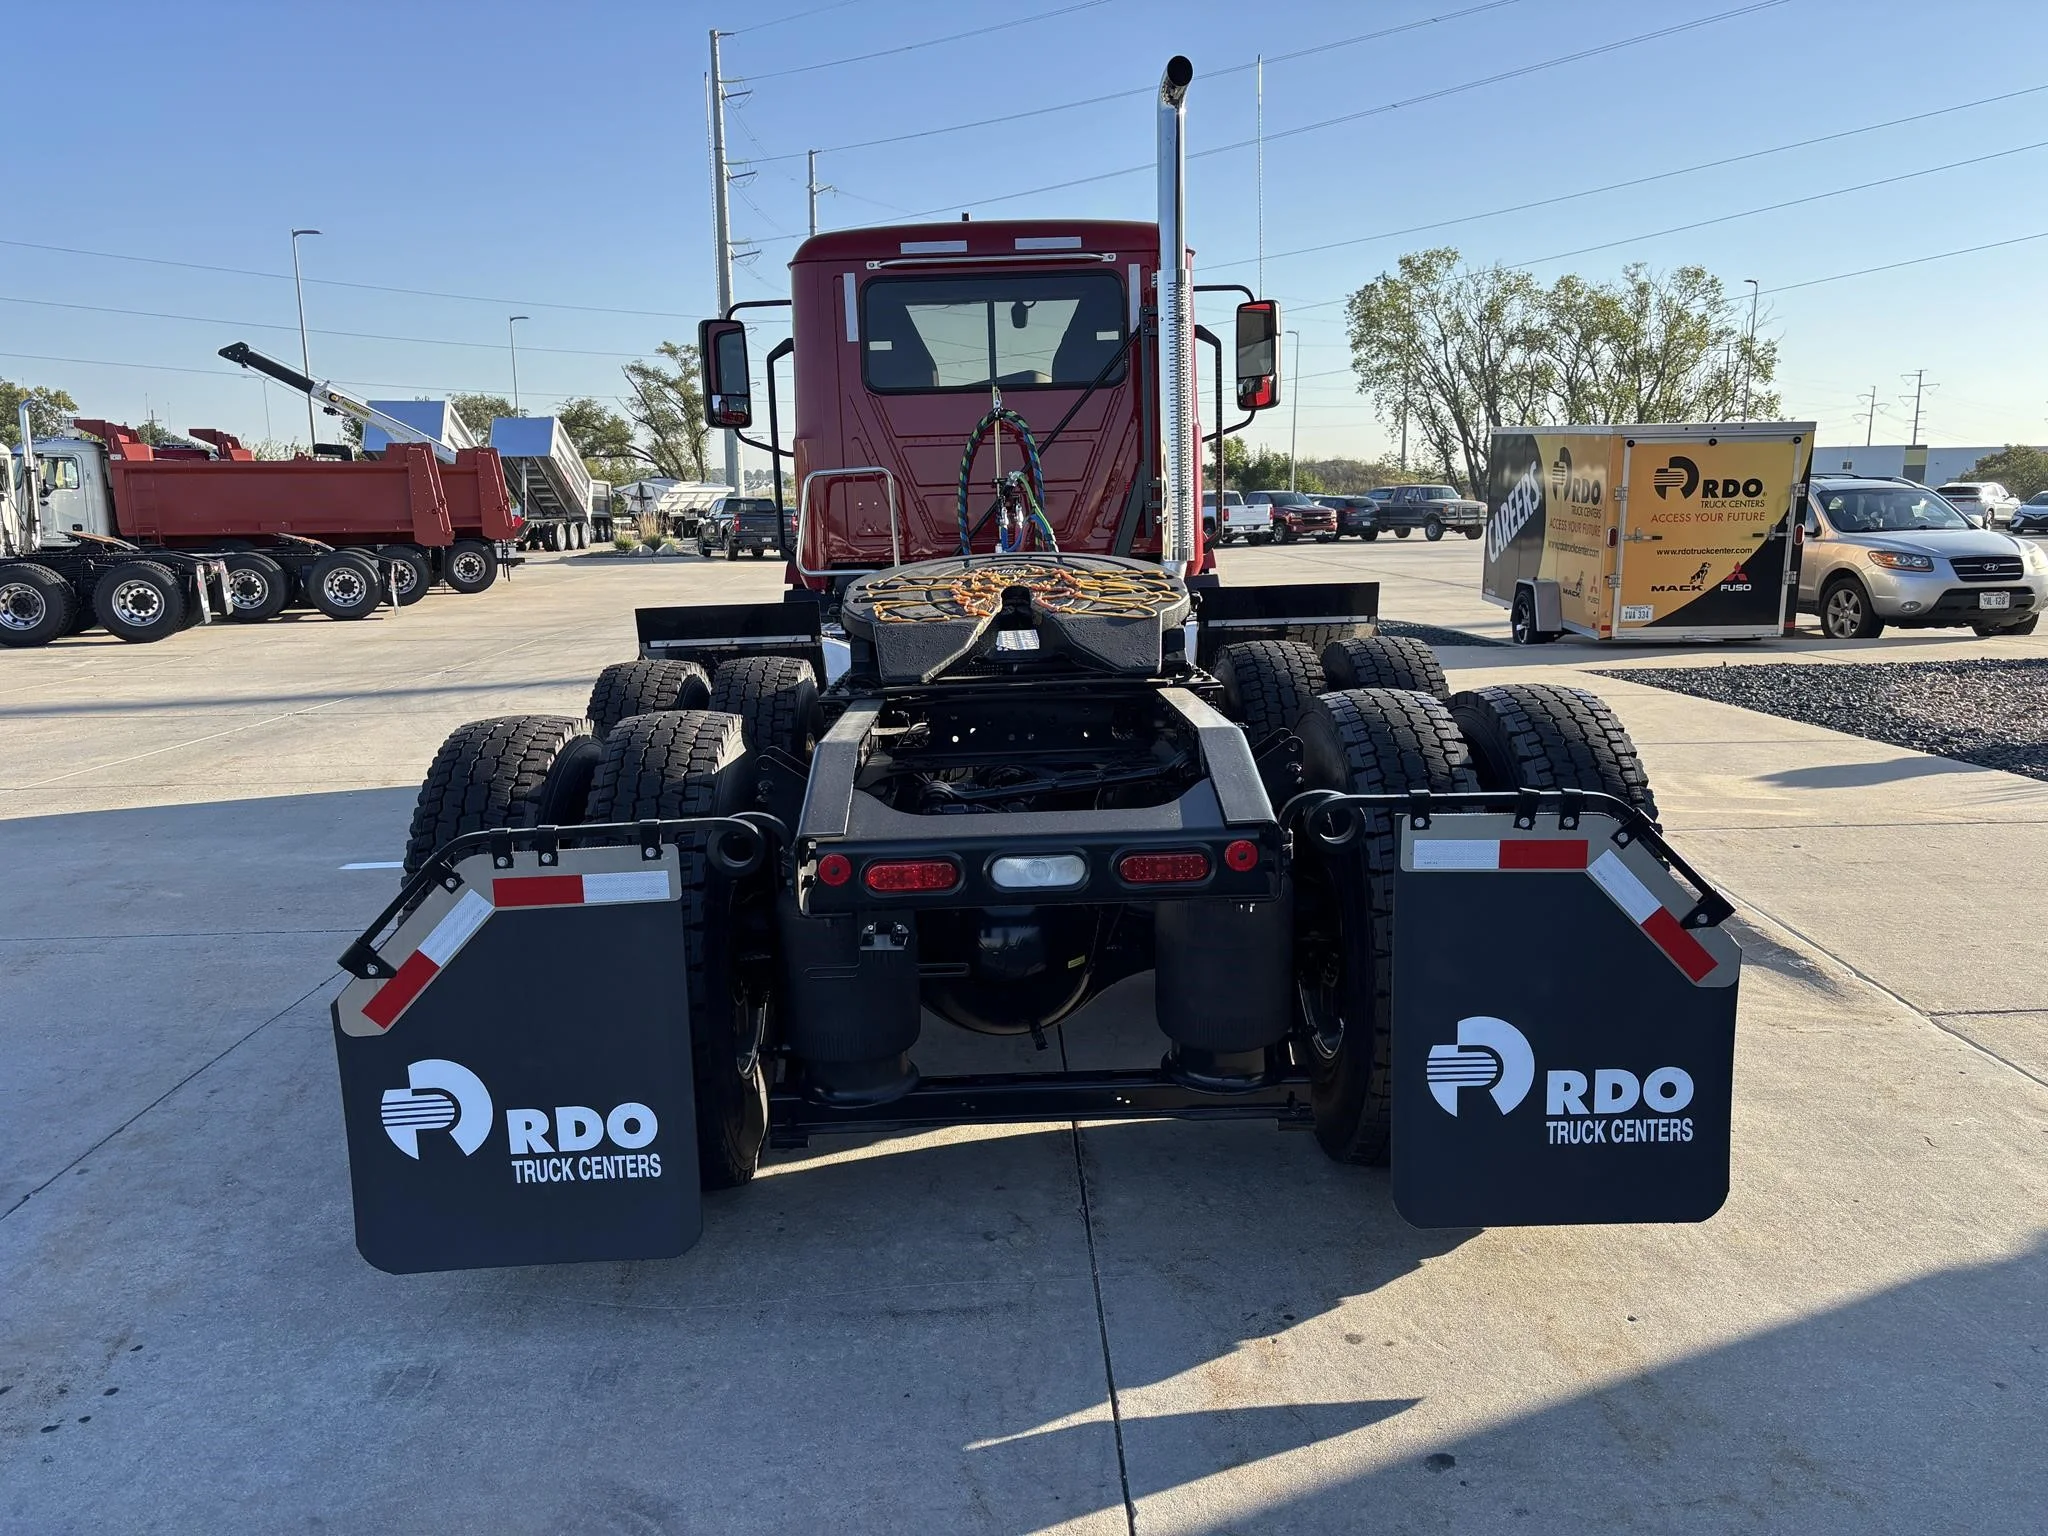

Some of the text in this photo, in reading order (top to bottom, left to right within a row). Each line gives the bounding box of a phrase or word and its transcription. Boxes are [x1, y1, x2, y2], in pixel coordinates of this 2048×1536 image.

[1572, 478, 1601, 506] RDO
[1702, 479, 1763, 498] RDO
[1488, 461, 1540, 563] CAREERS
[1651, 511, 1766, 523] ACCESS YOUR FUTURE
[1701, 500, 1765, 509] TRUCK CENTERS
[1656, 547, 1753, 555] www.rdotruckcenter.com
[1563, 587, 1581, 598] MACK
[1546, 1066, 1694, 1115] RDO
[506, 1102, 658, 1155] RDO
[1546, 1117, 1694, 1144] TRUCK CENTERS
[511, 1153, 662, 1184] TRUCK CENTERS
